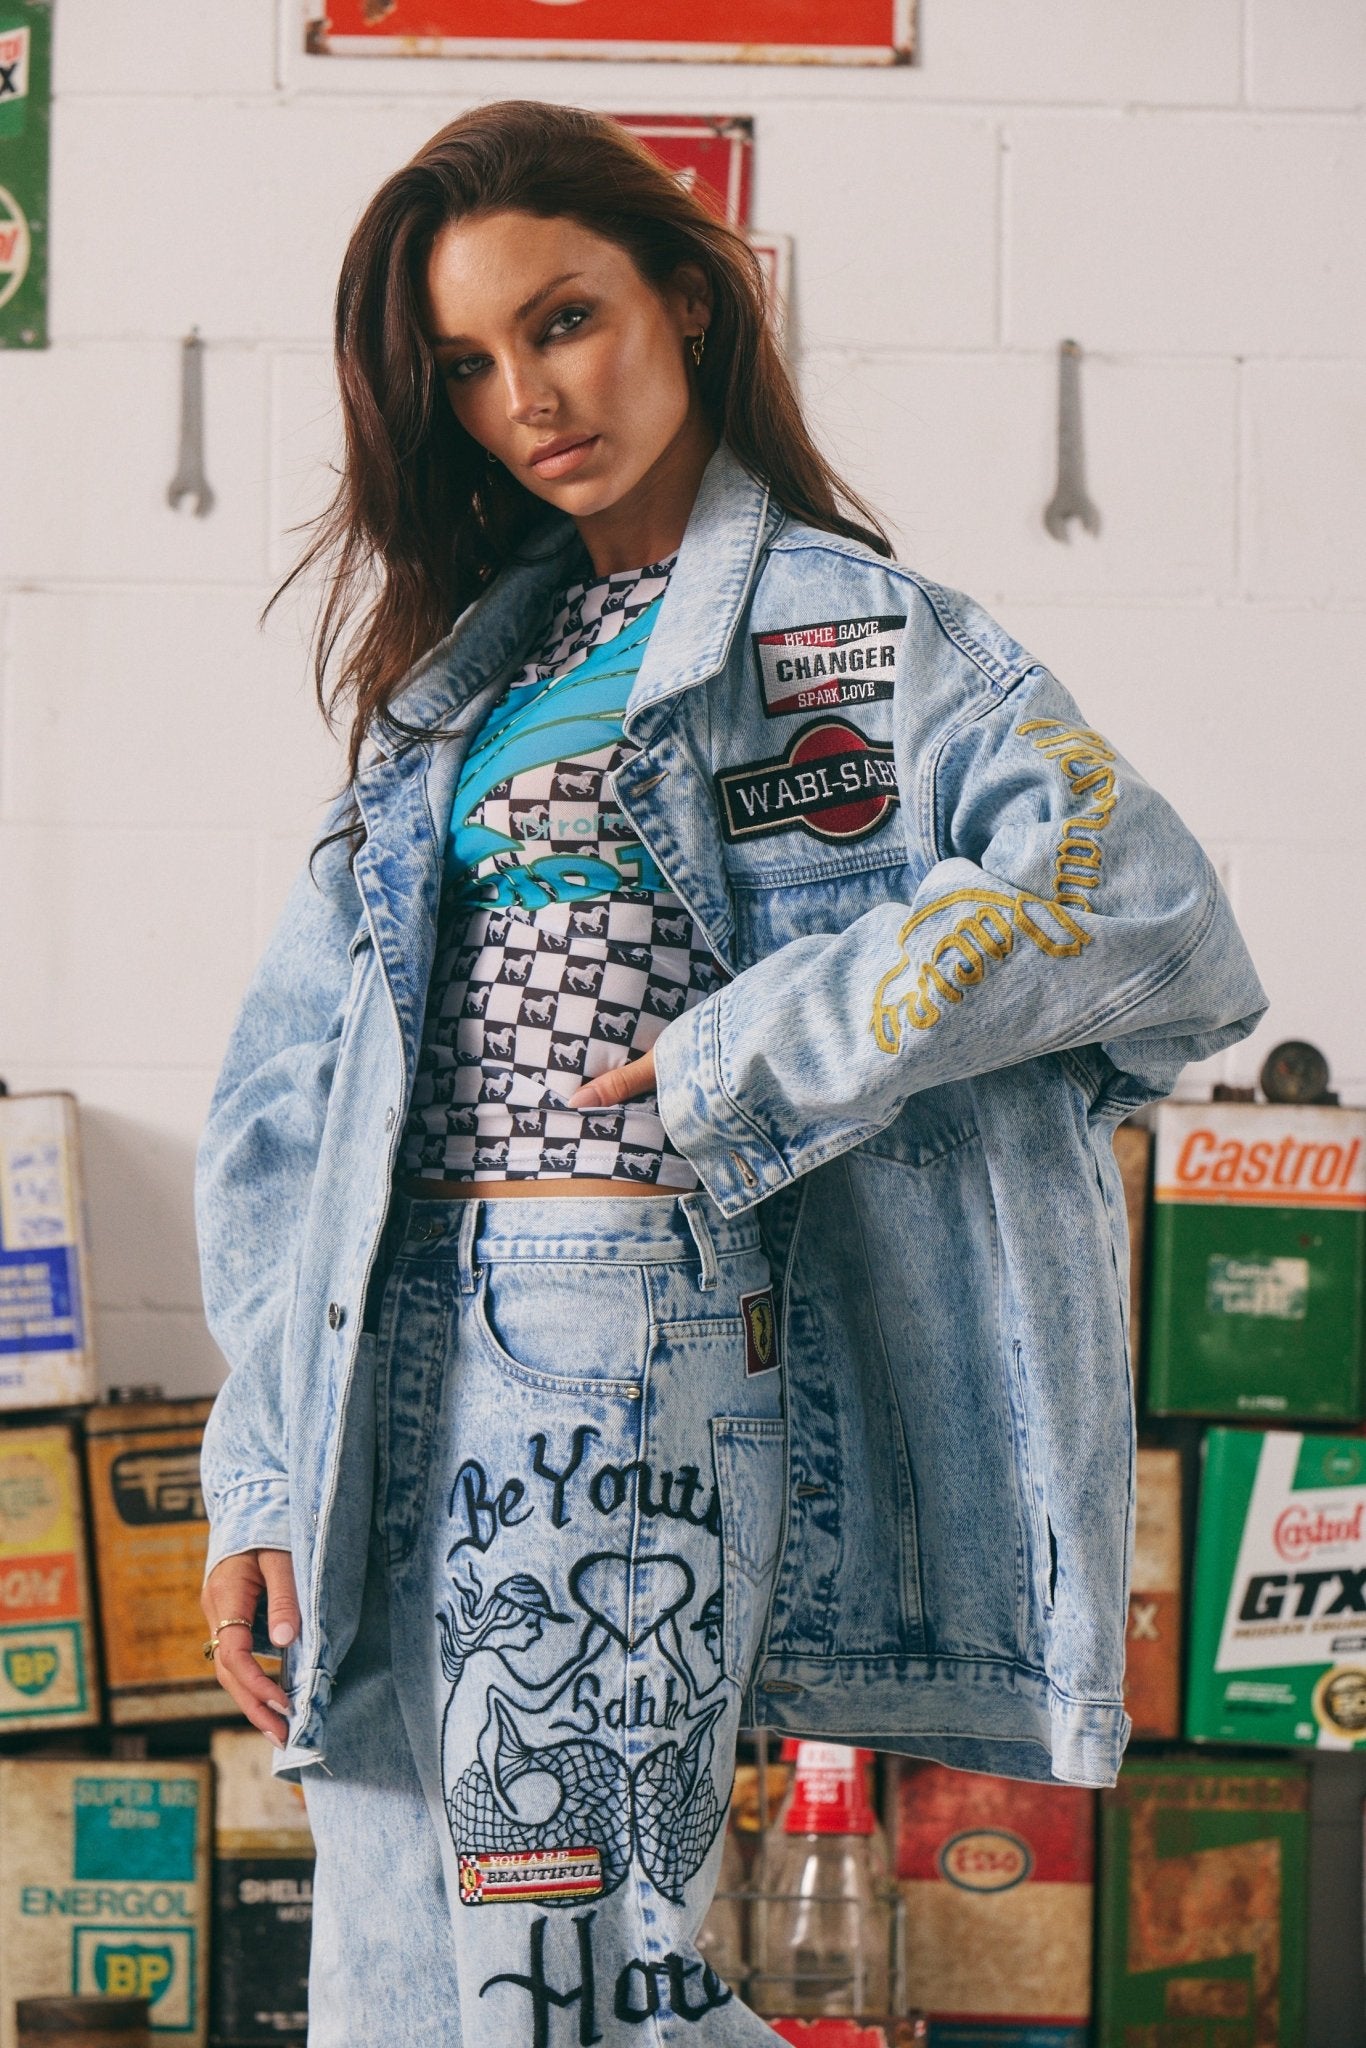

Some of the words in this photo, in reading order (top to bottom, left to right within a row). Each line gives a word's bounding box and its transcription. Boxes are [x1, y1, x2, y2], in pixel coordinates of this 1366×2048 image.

[838, 621, 879, 640] GAME
[776, 645, 895, 683] CHANGER
[797, 687, 840, 708] SPARK
[841, 682, 875, 702] LOVE
[1175, 1128, 1361, 1189] Castrol
[447, 1459, 534, 1562] Be
[1272, 1503, 1364, 1564] Castrol
[1239, 1570, 1366, 1622] GTX
[11, 1651, 56, 1687] BP
[486, 1865, 600, 1884] BEAUTIFUL
[527, 1851, 570, 1864] ARE
[20, 1885, 198, 1919] ENERGOL
[105, 1952, 170, 1997] BP
